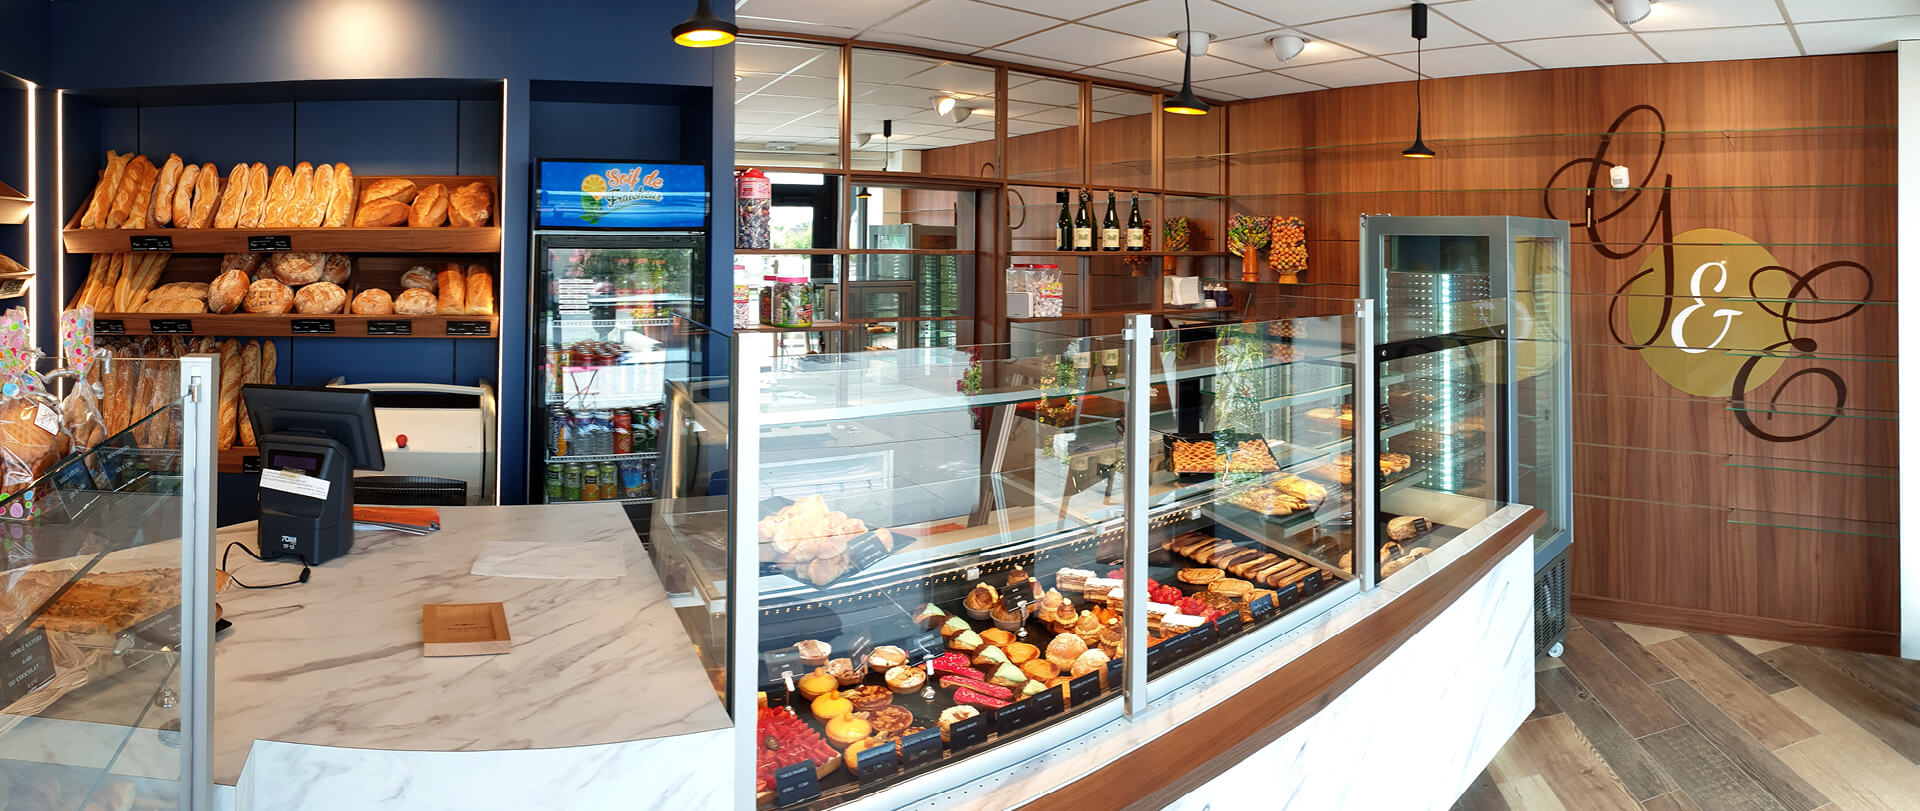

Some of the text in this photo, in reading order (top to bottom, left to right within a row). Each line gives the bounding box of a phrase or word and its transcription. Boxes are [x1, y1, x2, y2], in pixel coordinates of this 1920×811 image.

[606, 167, 663, 188] Soif de
[1671, 260, 1743, 354] &
